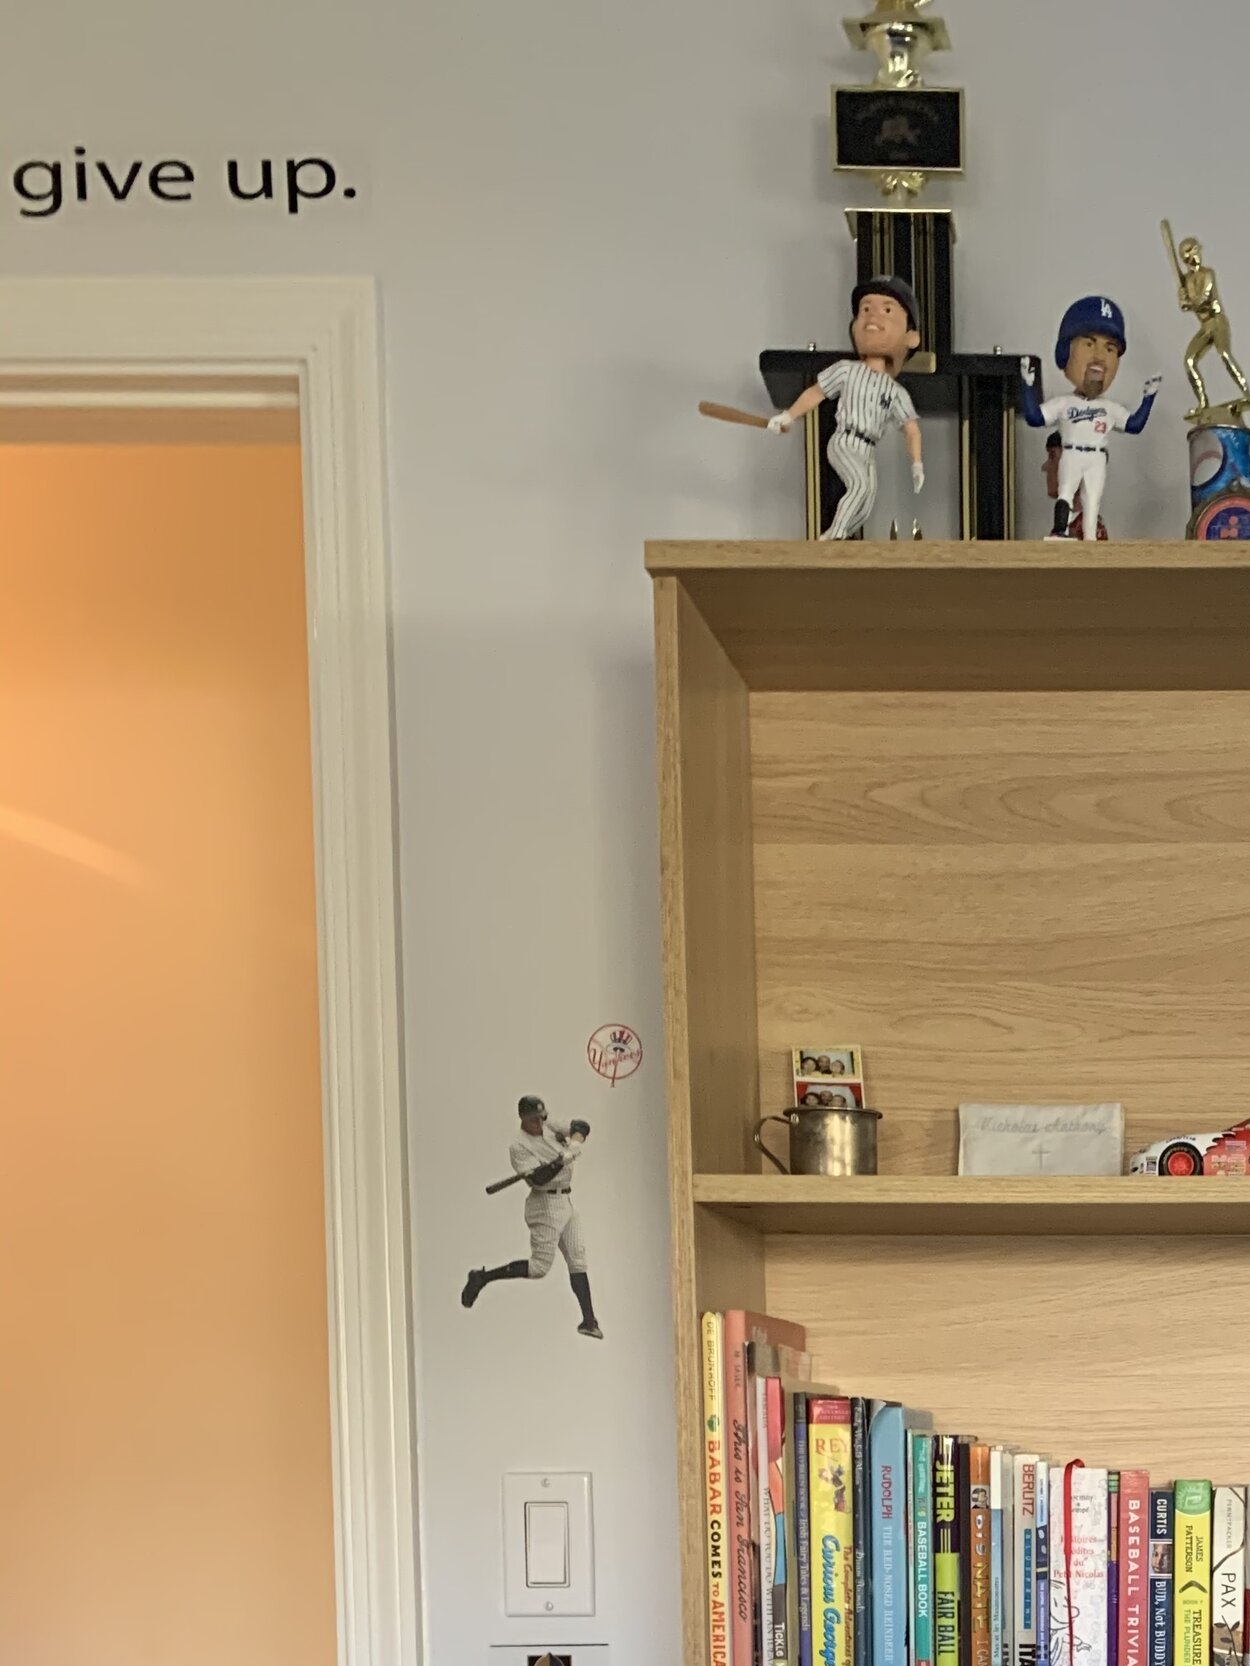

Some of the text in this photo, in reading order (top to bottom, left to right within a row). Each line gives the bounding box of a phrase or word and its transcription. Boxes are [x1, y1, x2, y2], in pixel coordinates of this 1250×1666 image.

[13, 146, 356, 217] give up.
[1094, 421, 1107, 434] 23
[706, 1321, 715, 1336] DE
[816, 1438, 849, 1456] REY
[708, 1440, 722, 1516] BABAR
[936, 1460, 955, 1523] JETER
[1022, 1464, 1035, 1516] BERLITZ
[733, 1420, 752, 1621] This is San Francisco
[1156, 1499, 1168, 1535] CURTIS
[711, 1519, 722, 1579] COMES
[821, 1535, 841, 1604] Curious
[843, 1545, 853, 1561] The
[881, 1465, 894, 1662] RUDOLPH THE RED-NOSED REINDEER
[917, 1521, 928, 1581] BASEBALL
[1127, 1499, 1141, 1596] BASEBALL
[1185, 1525, 1193, 1573] PATTERSON
[1195, 1535, 1204, 1562] JAMES
[712, 1582, 720, 1597] TO
[799, 1518, 811, 1631] Irish Fairy Tales & Legends
[972, 1562, 990, 1634] NATE
[1154, 1581, 1167, 1605] BUD,
[1221, 1572, 1237, 1609] PAX
[917, 1583, 928, 1618] BOOK
[937, 1591, 955, 1656] FAIR BALL
[1155, 1607, 1167, 1627] Not
[1183, 1609, 1191, 1625] THE
[1183, 1626, 1191, 1664] PLUNDER
[1192, 1609, 1202, 1665] TREASURE
